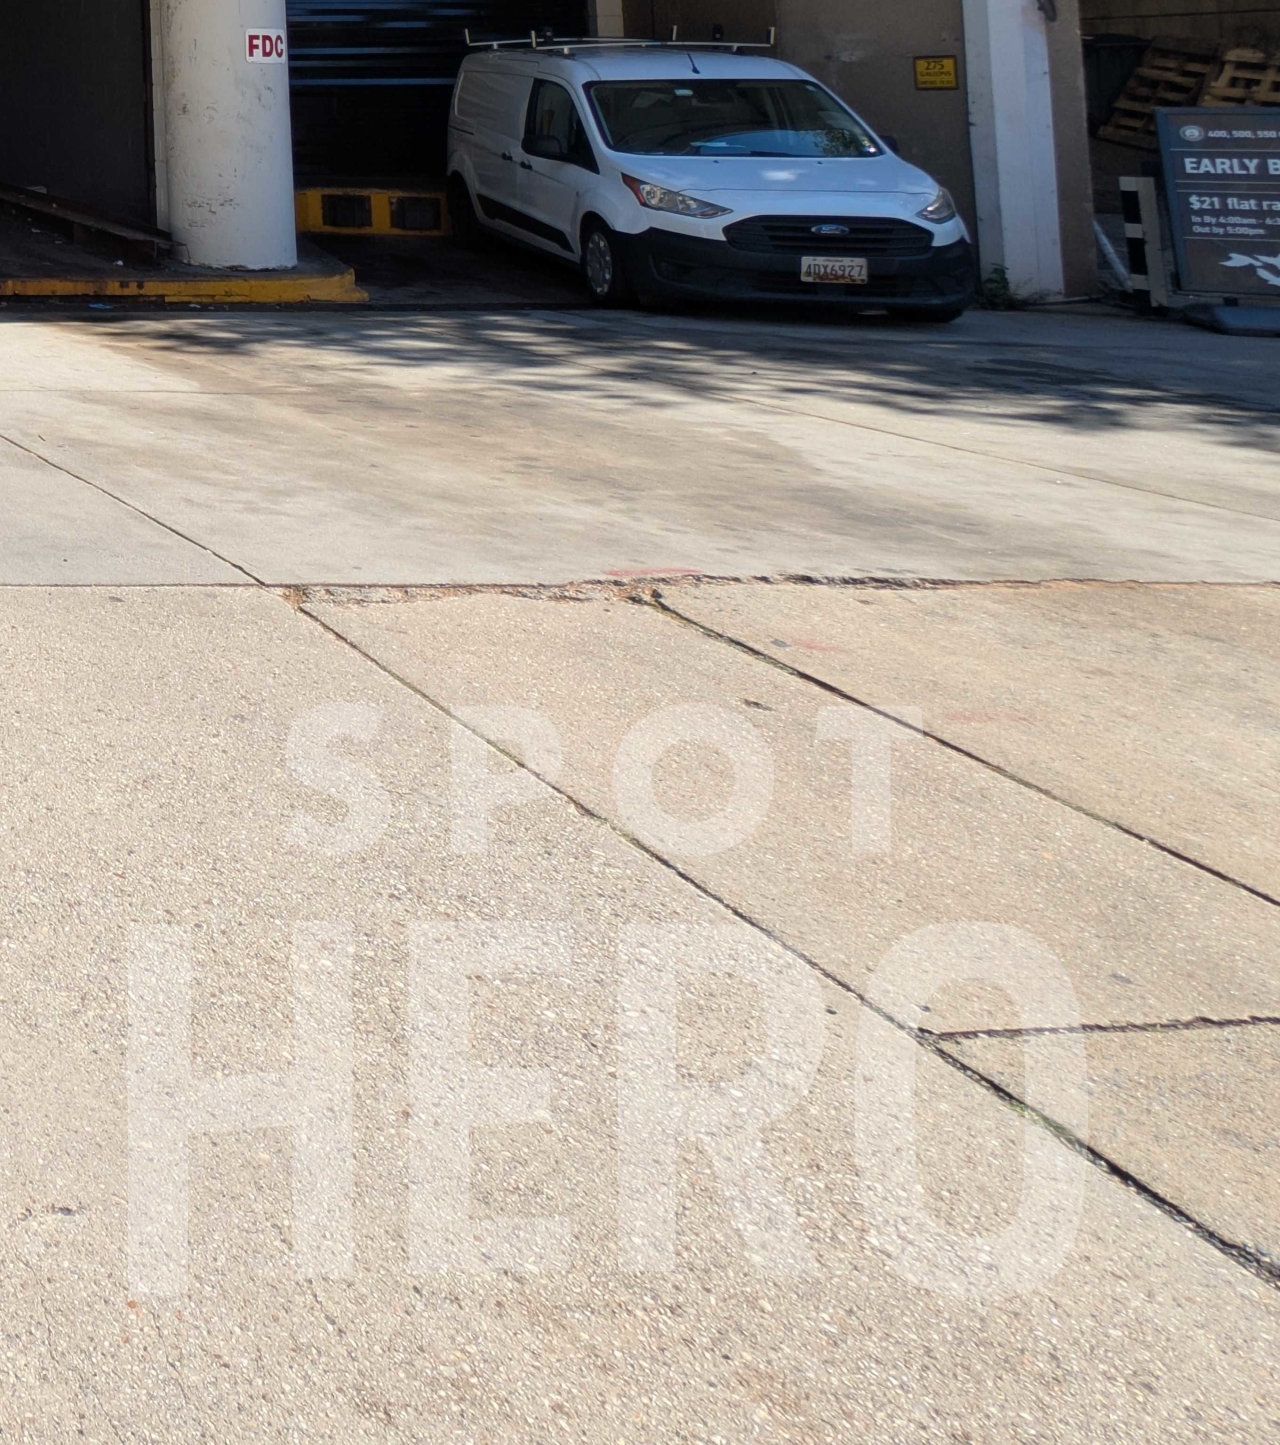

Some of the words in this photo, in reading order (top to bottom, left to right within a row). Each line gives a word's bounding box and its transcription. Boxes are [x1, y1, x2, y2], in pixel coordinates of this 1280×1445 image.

[248, 34, 284, 58] FDC
[923, 60, 945, 71] 275
[1183, 157, 1259, 175] EARLY
[1189, 194, 1220, 210] $21
[1226, 197, 1258, 210] flat
[806, 263, 864, 278] 4DX6927
